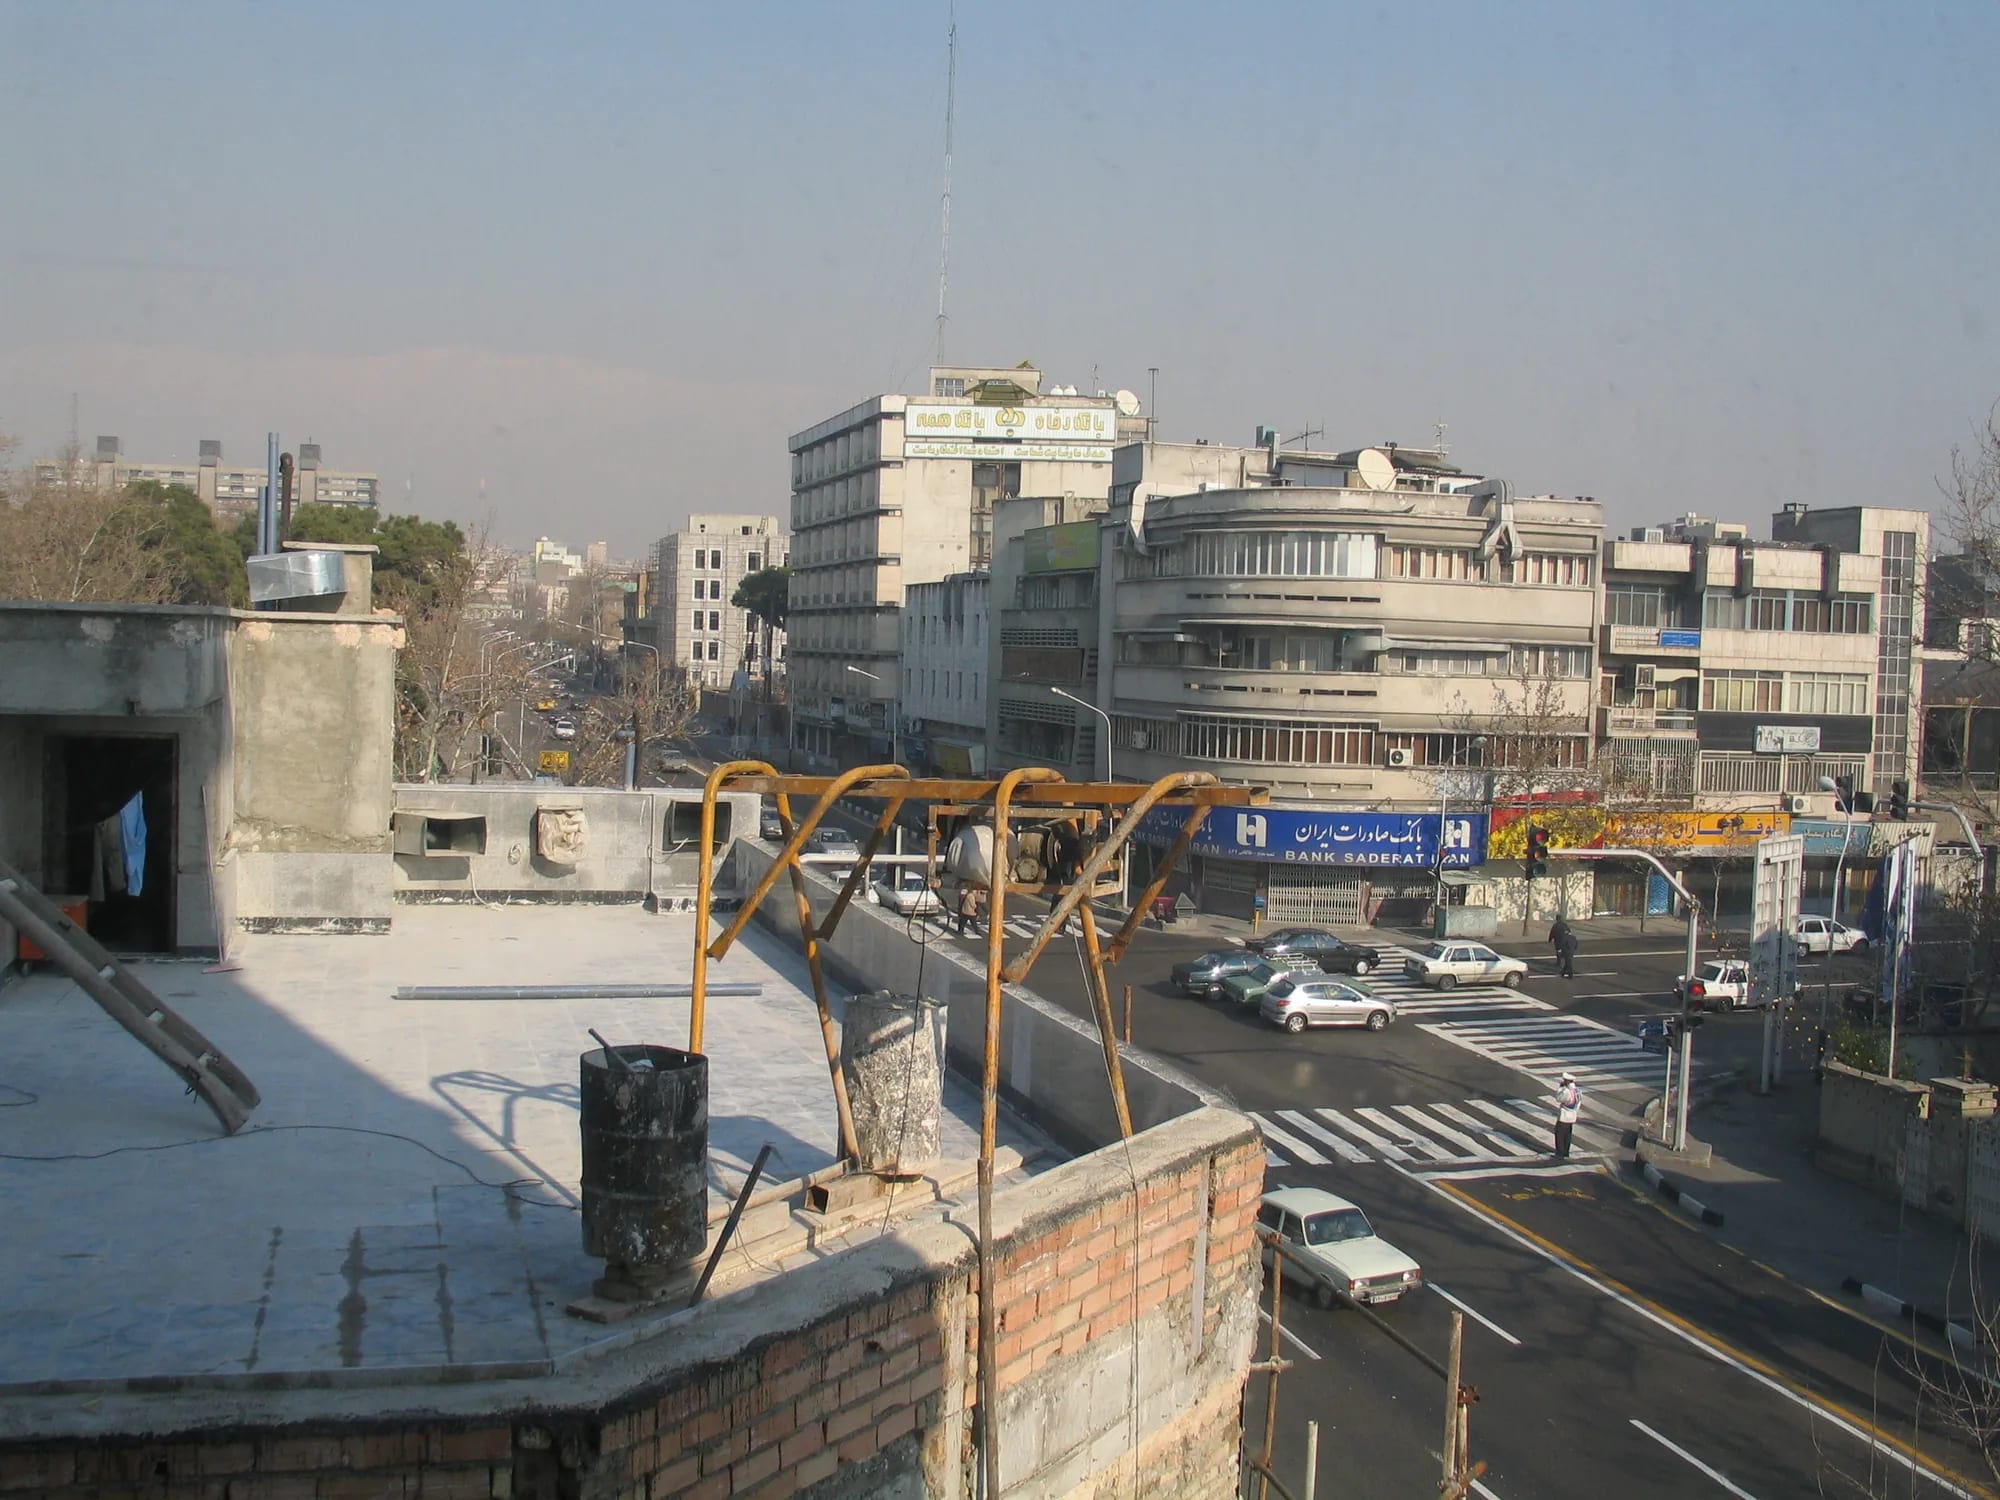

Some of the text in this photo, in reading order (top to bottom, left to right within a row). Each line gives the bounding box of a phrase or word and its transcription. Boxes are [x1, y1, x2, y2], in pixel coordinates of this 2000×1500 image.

[955, 410, 985, 436] بانک
[1036, 407, 1071, 431] رفاه
[1074, 412, 1105, 438] بانک
[1295, 817, 1423, 850] بانک صادرات ایران
[1285, 850, 1470, 864] BANK SADERAT IAN
